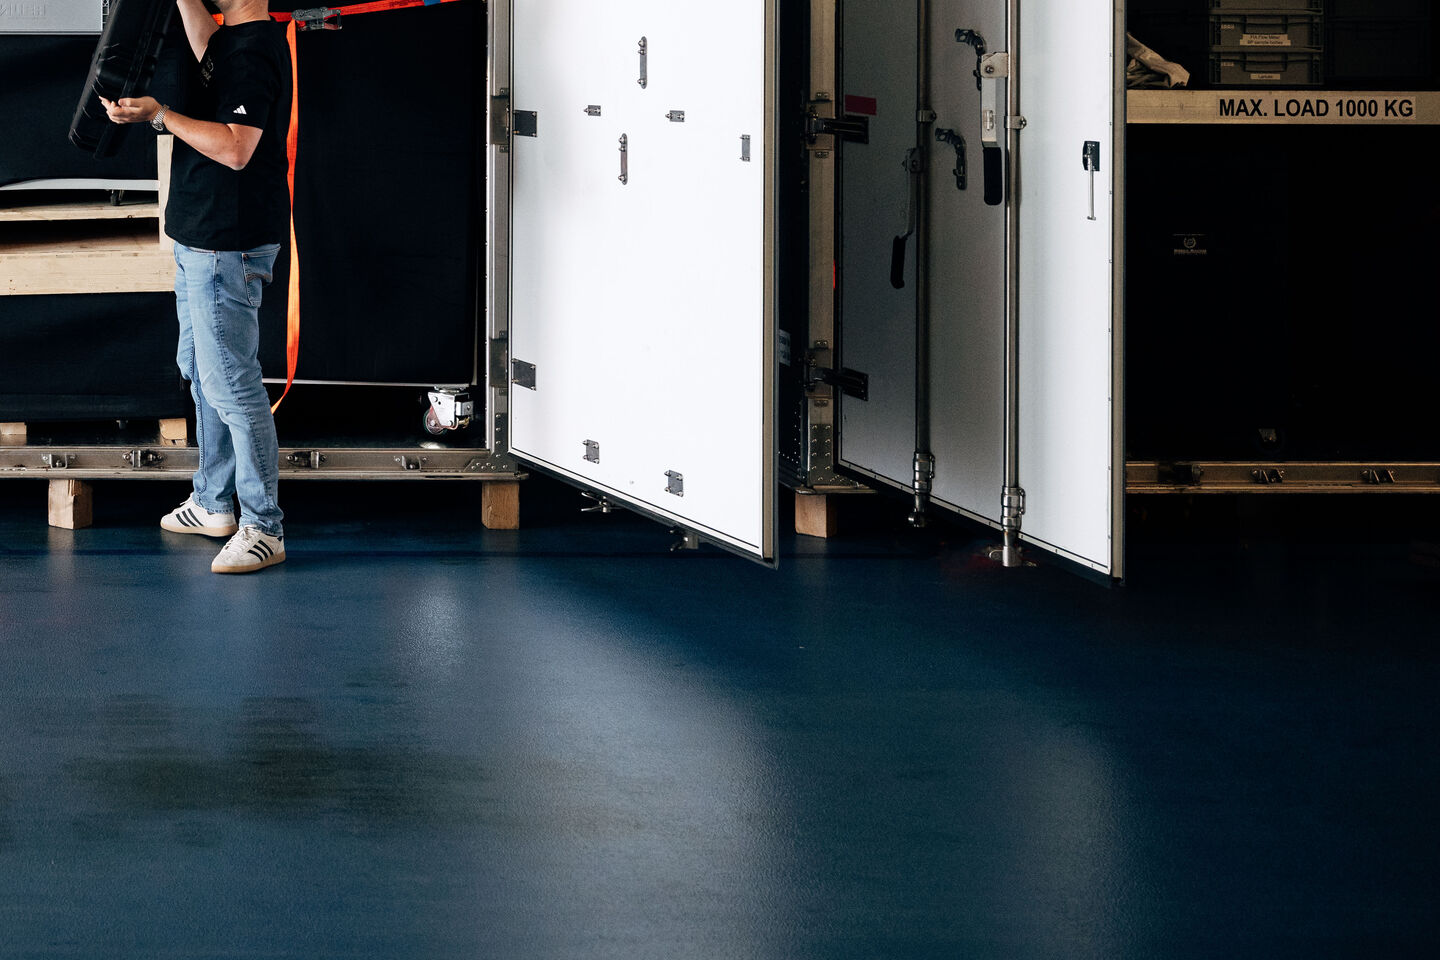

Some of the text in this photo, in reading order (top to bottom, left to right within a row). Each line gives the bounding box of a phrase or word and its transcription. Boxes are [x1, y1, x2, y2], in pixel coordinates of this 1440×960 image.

[1219, 98, 1414, 117] MAX. LOAD 1000 KG
